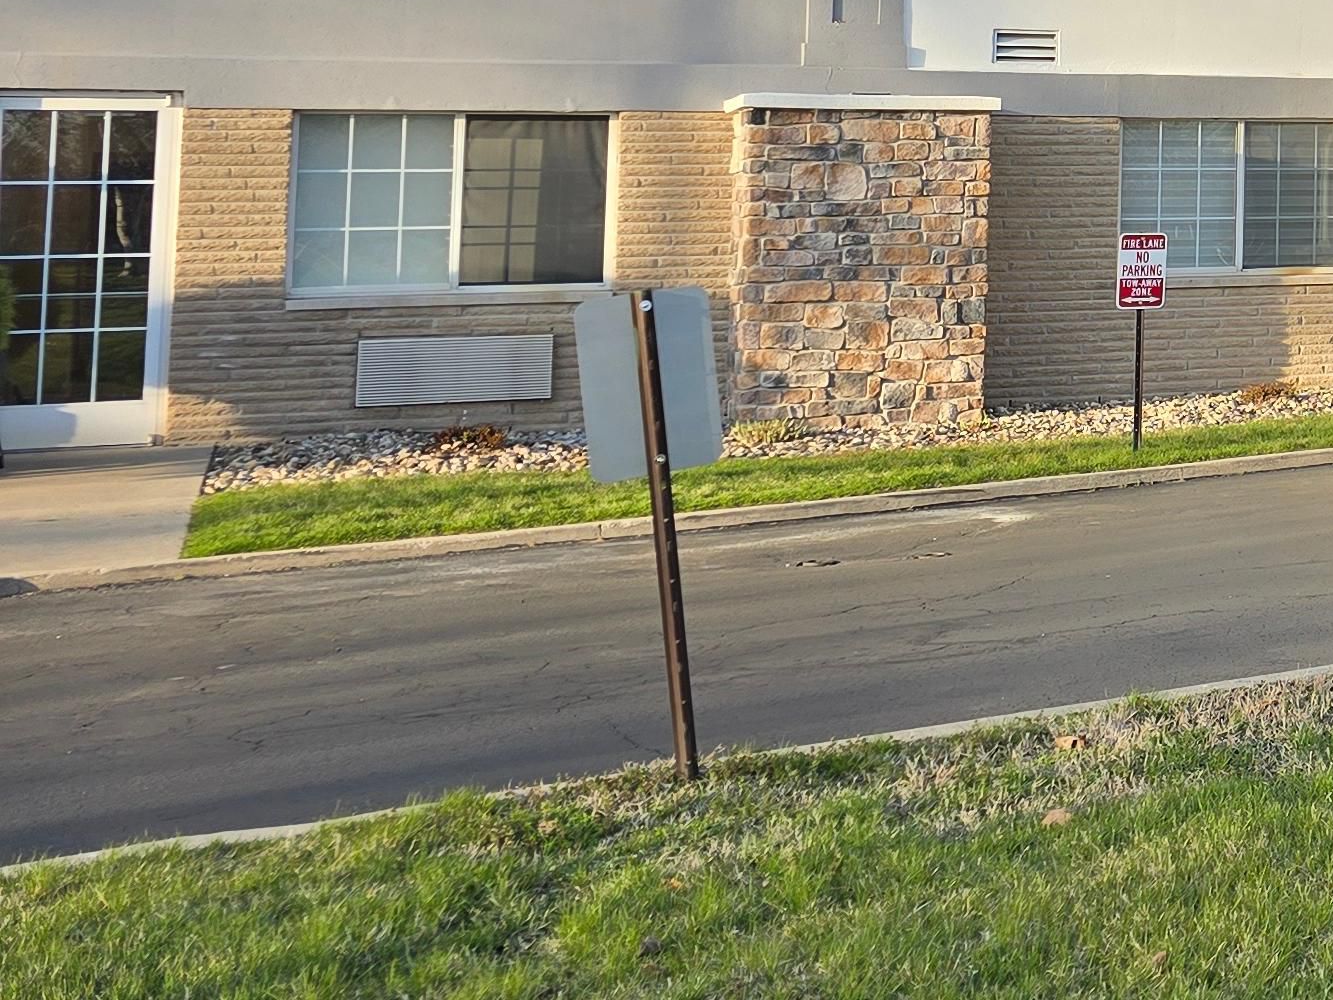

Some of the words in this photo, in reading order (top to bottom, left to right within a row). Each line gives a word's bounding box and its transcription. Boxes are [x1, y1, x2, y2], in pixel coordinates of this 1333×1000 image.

[1123, 239, 1140, 248] FIRE
[1143, 239, 1164, 248] LANE
[1136, 251, 1149, 263] NO
[1122, 264, 1162, 276] PARKING
[1122, 279, 1161, 287] TOW-AWAY
[1131, 288, 1152, 296] ZONE
